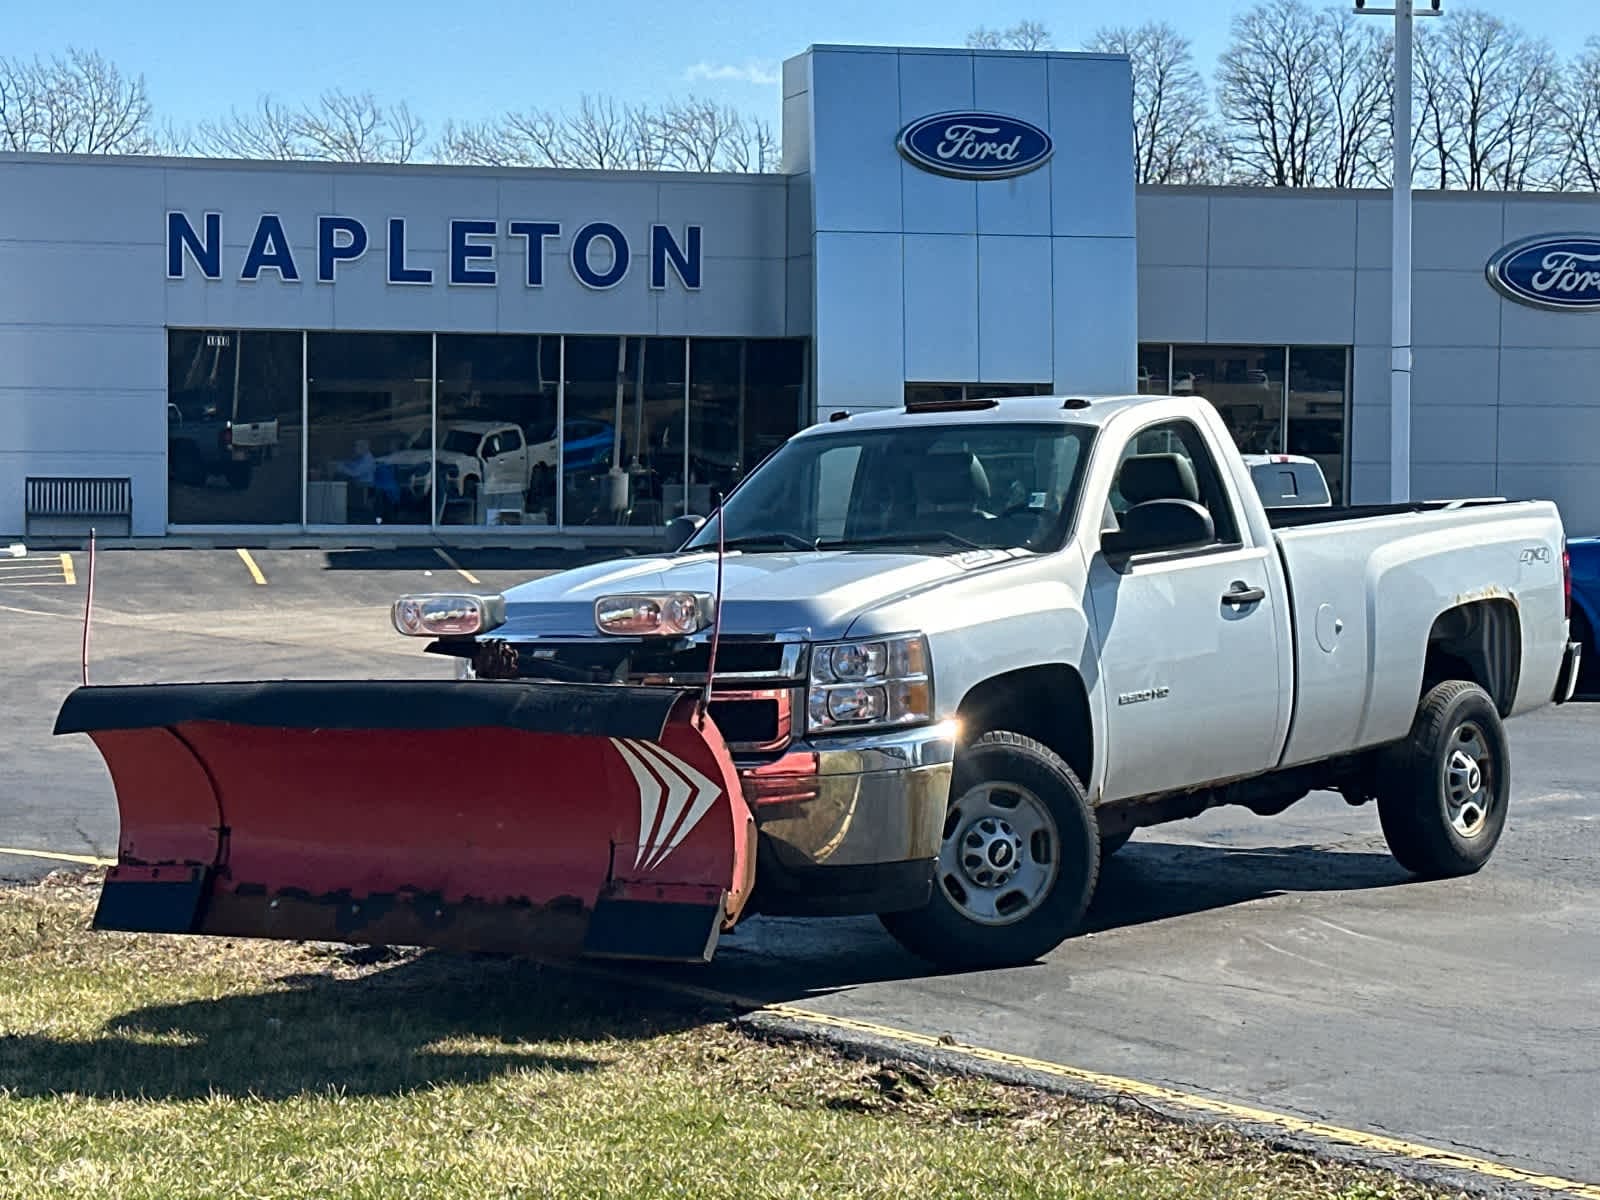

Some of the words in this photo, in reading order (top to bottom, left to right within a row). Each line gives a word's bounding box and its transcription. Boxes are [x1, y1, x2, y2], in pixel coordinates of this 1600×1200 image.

[937, 124, 1021, 160] Ford
[166, 211, 703, 290] NAPLETON
[1532, 251, 1600, 291] For
